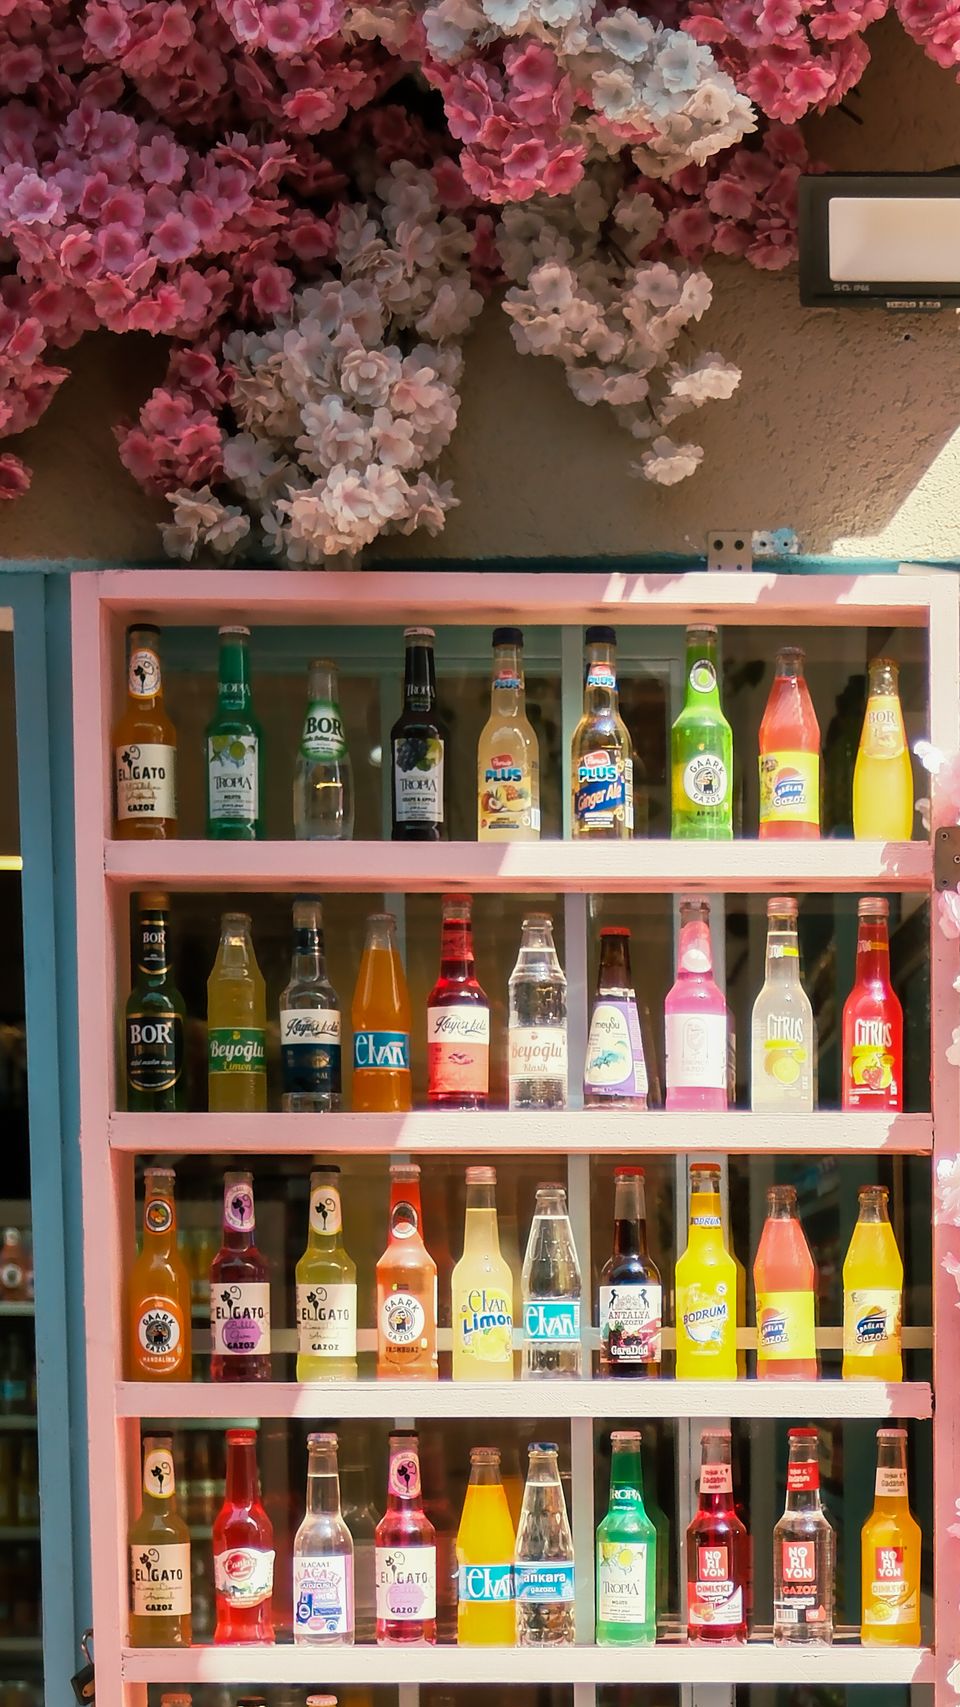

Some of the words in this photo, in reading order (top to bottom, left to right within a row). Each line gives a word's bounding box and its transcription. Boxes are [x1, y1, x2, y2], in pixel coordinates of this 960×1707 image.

[586, 675, 615, 687] PLUS
[306, 717, 344, 737] BOR
[118, 767, 129, 781] EL
[132, 766, 166, 780] GATO
[688, 758, 725, 776] GAARK
[484, 768, 522, 782] PLUS
[577, 766, 619, 783] PLUS
[213, 776, 252, 791] TROPIA
[400, 778, 437, 793] TROPIA
[577, 790, 607, 812] Ginger
[606, 782, 623, 802] Ale
[692, 792, 722, 805] GAZOZ
[127, 803, 156, 812] GAZOZ
[143, 931, 166, 945] BOR
[130, 1023, 173, 1044] BOR
[209, 1040, 265, 1064] Beyoğlu
[511, 1040, 562, 1065] Beyoğlu
[223, 1061, 252, 1072] Limon
[384, 1297, 421, 1313] GAARK
[216, 1306, 229, 1320] EL
[232, 1306, 265, 1320] GATO
[302, 1308, 315, 1321] EL
[318, 1308, 350, 1321] GATO
[608, 1310, 651, 1321] ANTALYA
[683, 1304, 727, 1326] BODRUM
[142, 1312, 176, 1328] GAARK
[462, 1313, 513, 1337] Limon
[387, 1330, 416, 1343] GAZOZ
[145, 1342, 172, 1353] GAZOZ
[227, 1342, 256, 1350] GAZOZ
[311, 1342, 340, 1350] GAZOZ
[704, 1550, 722, 1560] NO
[788, 1545, 808, 1556] NO
[881, 1549, 897, 1559] NO
[707, 1559, 720, 1568] RI
[791, 1555, 806, 1566] RI
[883, 1558, 895, 1568] RI
[135, 1568, 147, 1581] EL
[150, 1568, 183, 1581] GATO
[380, 1571, 390, 1584] EL
[396, 1571, 428, 1585] GATO
[522, 1570, 567, 1584] ankara
[702, 1566, 725, 1577] YON
[786, 1565, 813, 1578] YON
[878, 1567, 901, 1577] YON
[530, 1585, 557, 1595] gazozu
[603, 1580, 639, 1596] TROPIA
[782, 1585, 818, 1595] GAZOZ
[145, 1603, 173, 1611] GAZOZ
[390, 1606, 419, 1614] GAZOZ
